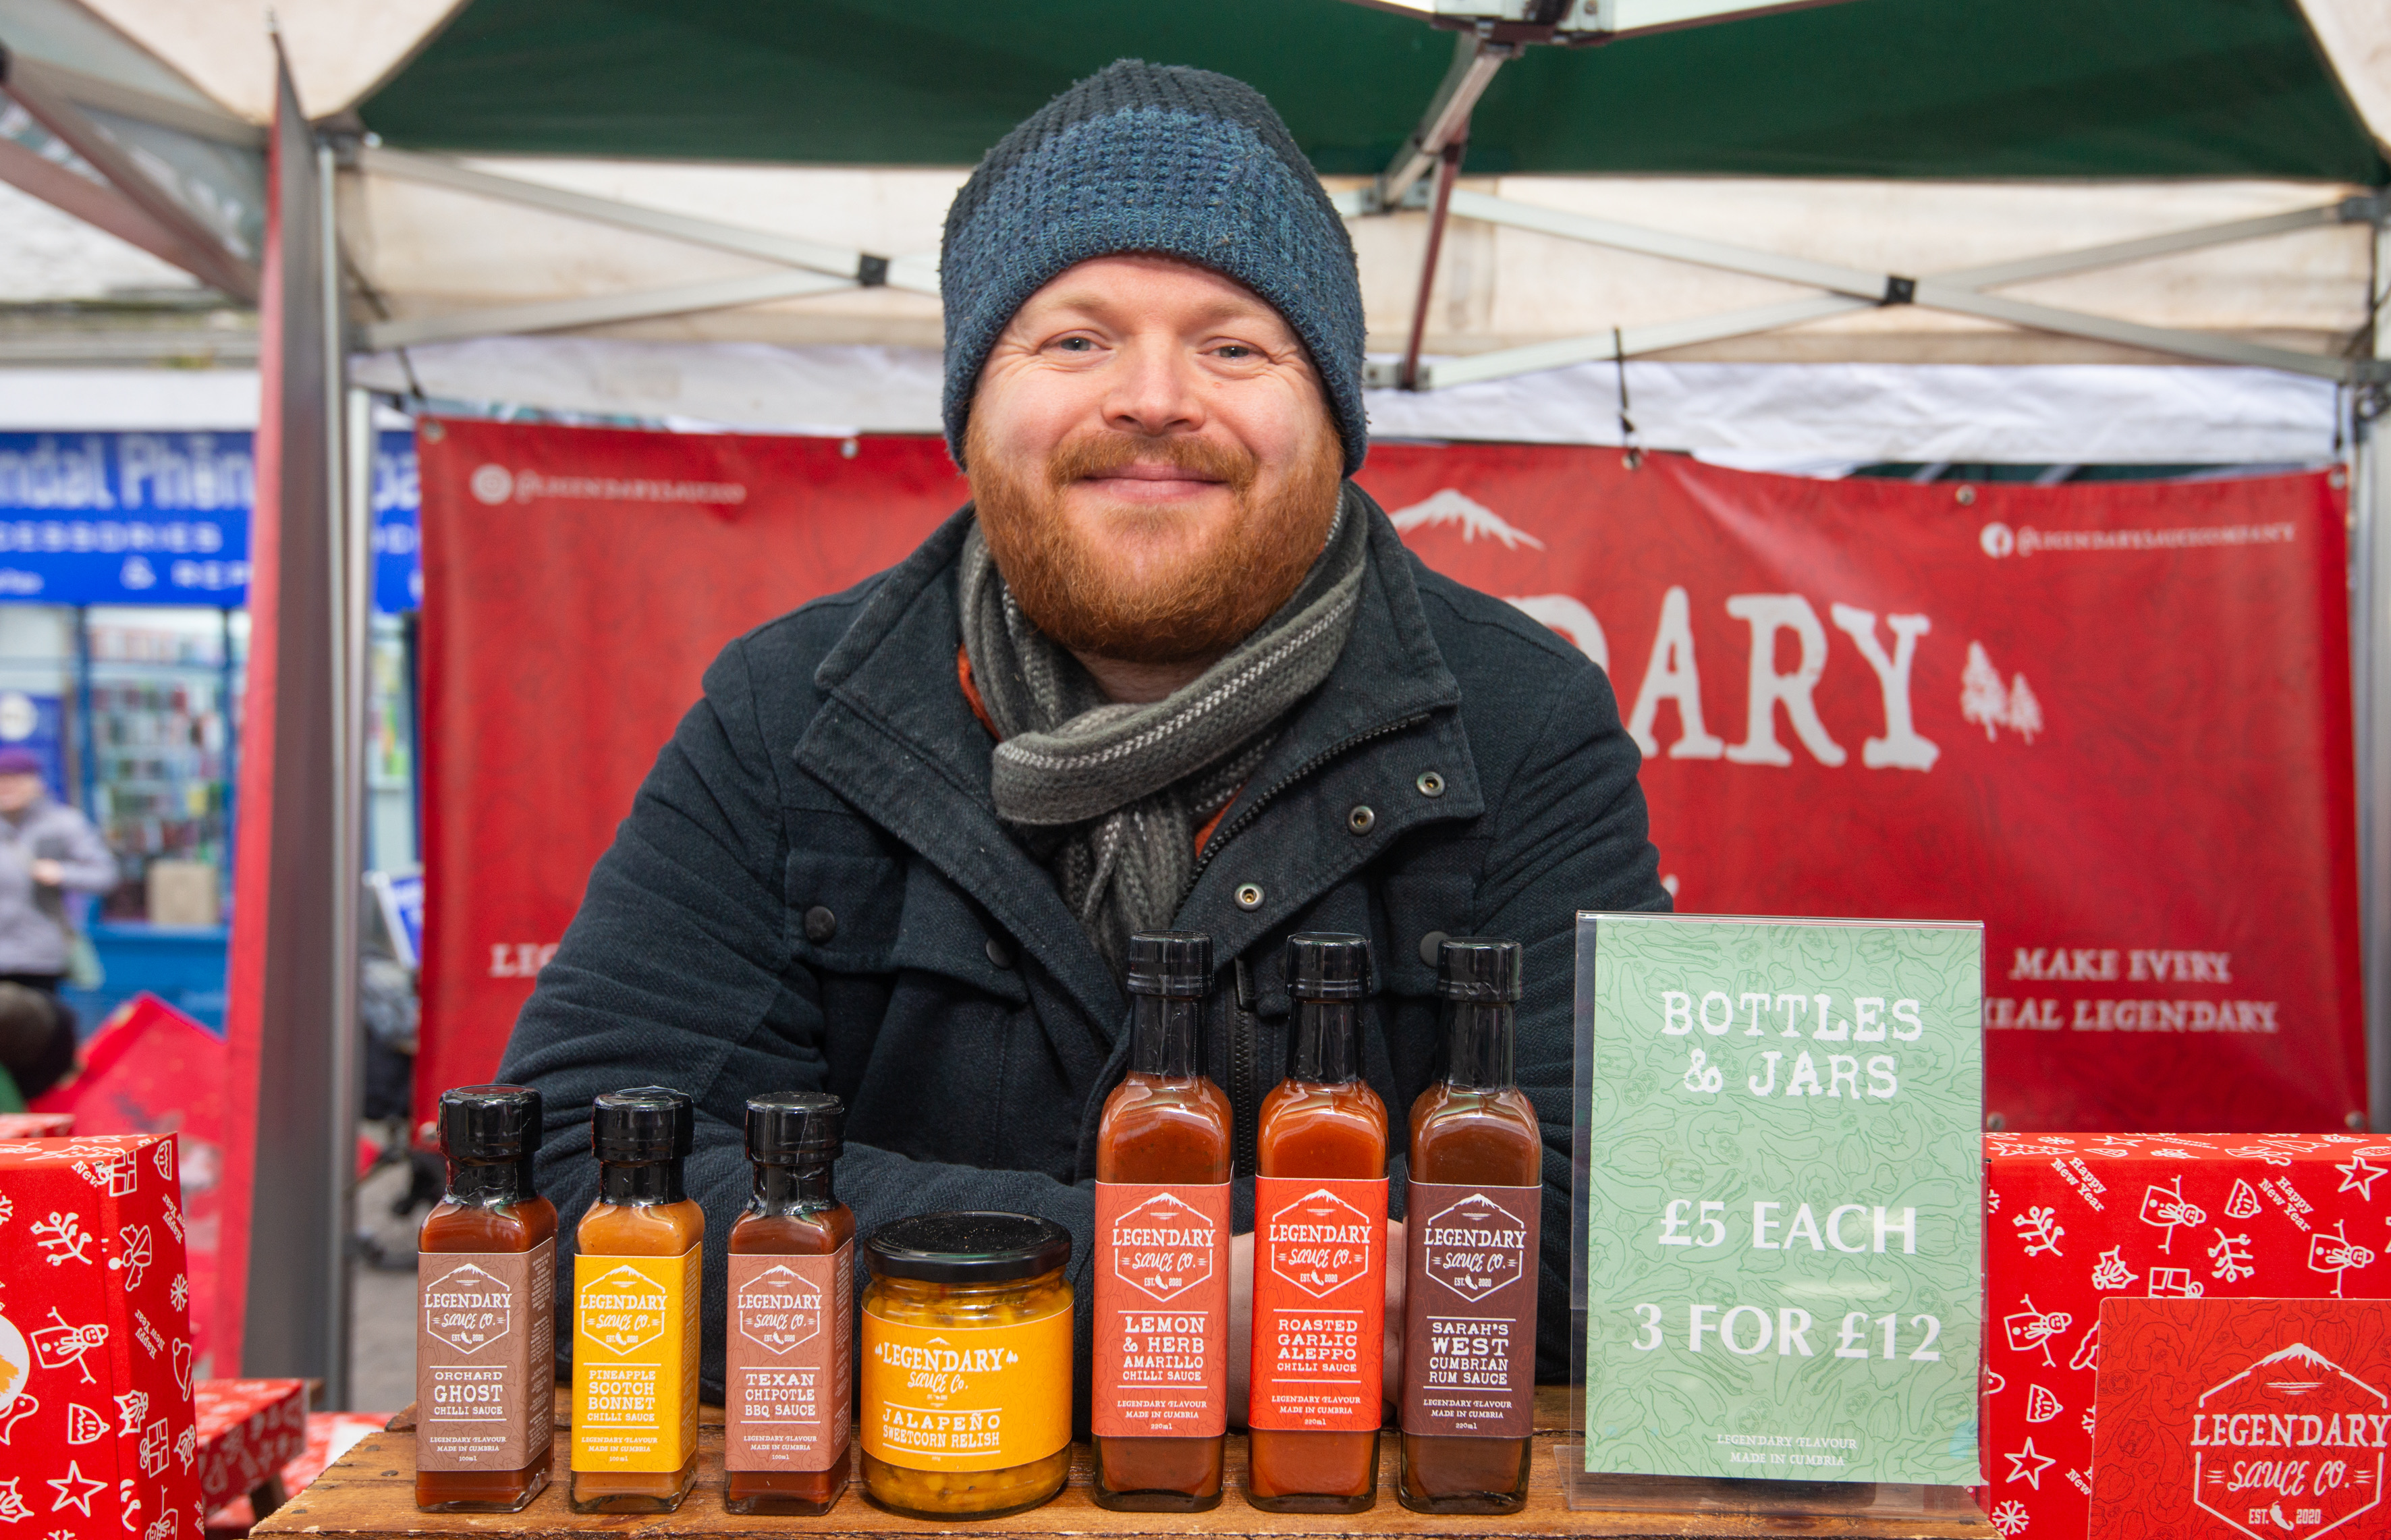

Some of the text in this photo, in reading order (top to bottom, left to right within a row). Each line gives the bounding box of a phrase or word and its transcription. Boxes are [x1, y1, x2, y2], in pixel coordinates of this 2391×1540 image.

[2009, 947, 2118, 981] MAKE
[1661, 990, 1923, 1042] BOTTLES
[2071, 999, 2278, 1033] LEGENDARY
[1683, 1047, 1897, 1099] & JARS
[2068, 1156, 2107, 1194] Happy
[2050, 1157, 2106, 1212] New Year
[2276, 1176, 2314, 1214] Happy
[2258, 1178, 2311, 1232] New Year
[1269, 1224, 1372, 1244] LEGENDARY
[1658, 1199, 1916, 1254] £5 EACH
[1111, 1228, 1216, 1247] LEGENDARY
[1423, 1228, 1527, 1248] LEGENDARY
[1144, 1277, 1182, 1287] EST. 2020
[1300, 1273, 1338, 1283] EST. 2020
[1454, 1277, 1465, 1287] EST.
[424, 1293, 512, 1309] LEGENDARY
[579, 1294, 668, 1311] LEGENDARY
[737, 1294, 823, 1310] LEGENDARY
[134, 1309, 165, 1352] New Year
[1124, 1316, 1205, 1333] LEMON
[1278, 1319, 1358, 1332] ROASTED
[1433, 1322, 1508, 1336] SARAH'S
[1632, 1303, 1940, 1361] 3 FOR £12
[135, 1327, 157, 1360] Happy
[451, 1333, 461, 1342] EST.
[1123, 1336, 1205, 1354] & HERB
[1277, 1333, 1357, 1347] GARLIC
[1277, 1347, 1356, 1360] ALEPPO
[1431, 1337, 1509, 1356] WEST
[883, 1342, 1005, 1373] LEGENDARY
[1123, 1355, 1203, 1369] AMARILLO
[1429, 1357, 1508, 1371] CUMBRIAN
[1277, 1363, 1357, 1372] CHILLI SAUCE
[435, 1372, 502, 1381] ORCHARD
[588, 1370, 656, 1381] PINEAPPLE
[746, 1373, 815, 1386] TEXAN
[1123, 1371, 1201, 1381] CHILLI SAUCE
[1429, 1371, 1507, 1385] RUM SAUCE
[434, 1385, 503, 1403] GHOST
[588, 1381, 655, 1396] SCOTCH
[745, 1388, 815, 1401] CHIPOTLE
[434, 1406, 503, 1415] CHILLI SAUCE
[588, 1396, 655, 1410] BONNET
[1317, 1406, 1352, 1414] CUMBRIA
[1423, 1399, 1512, 1408] LEGENDARY FLAVOUR
[587, 1412, 655, 1422] CHILLI SAUCE
[744, 1404, 815, 1418] BBQ SAUCE
[883, 1408, 1000, 1431] JALAPEÑO
[883, 1425, 999, 1448] SWEETCORN RELISH
[2190, 1412, 2391, 1448] LEGENDARY
[750, 1443, 771, 1451] MADE
[1717, 1434, 1857, 1449] LEGENDARY FLAVOUR
[1730, 1452, 1845, 1466] MADE IN CUMBRIA
[2249, 1508, 2321, 1524] EST. 2020
